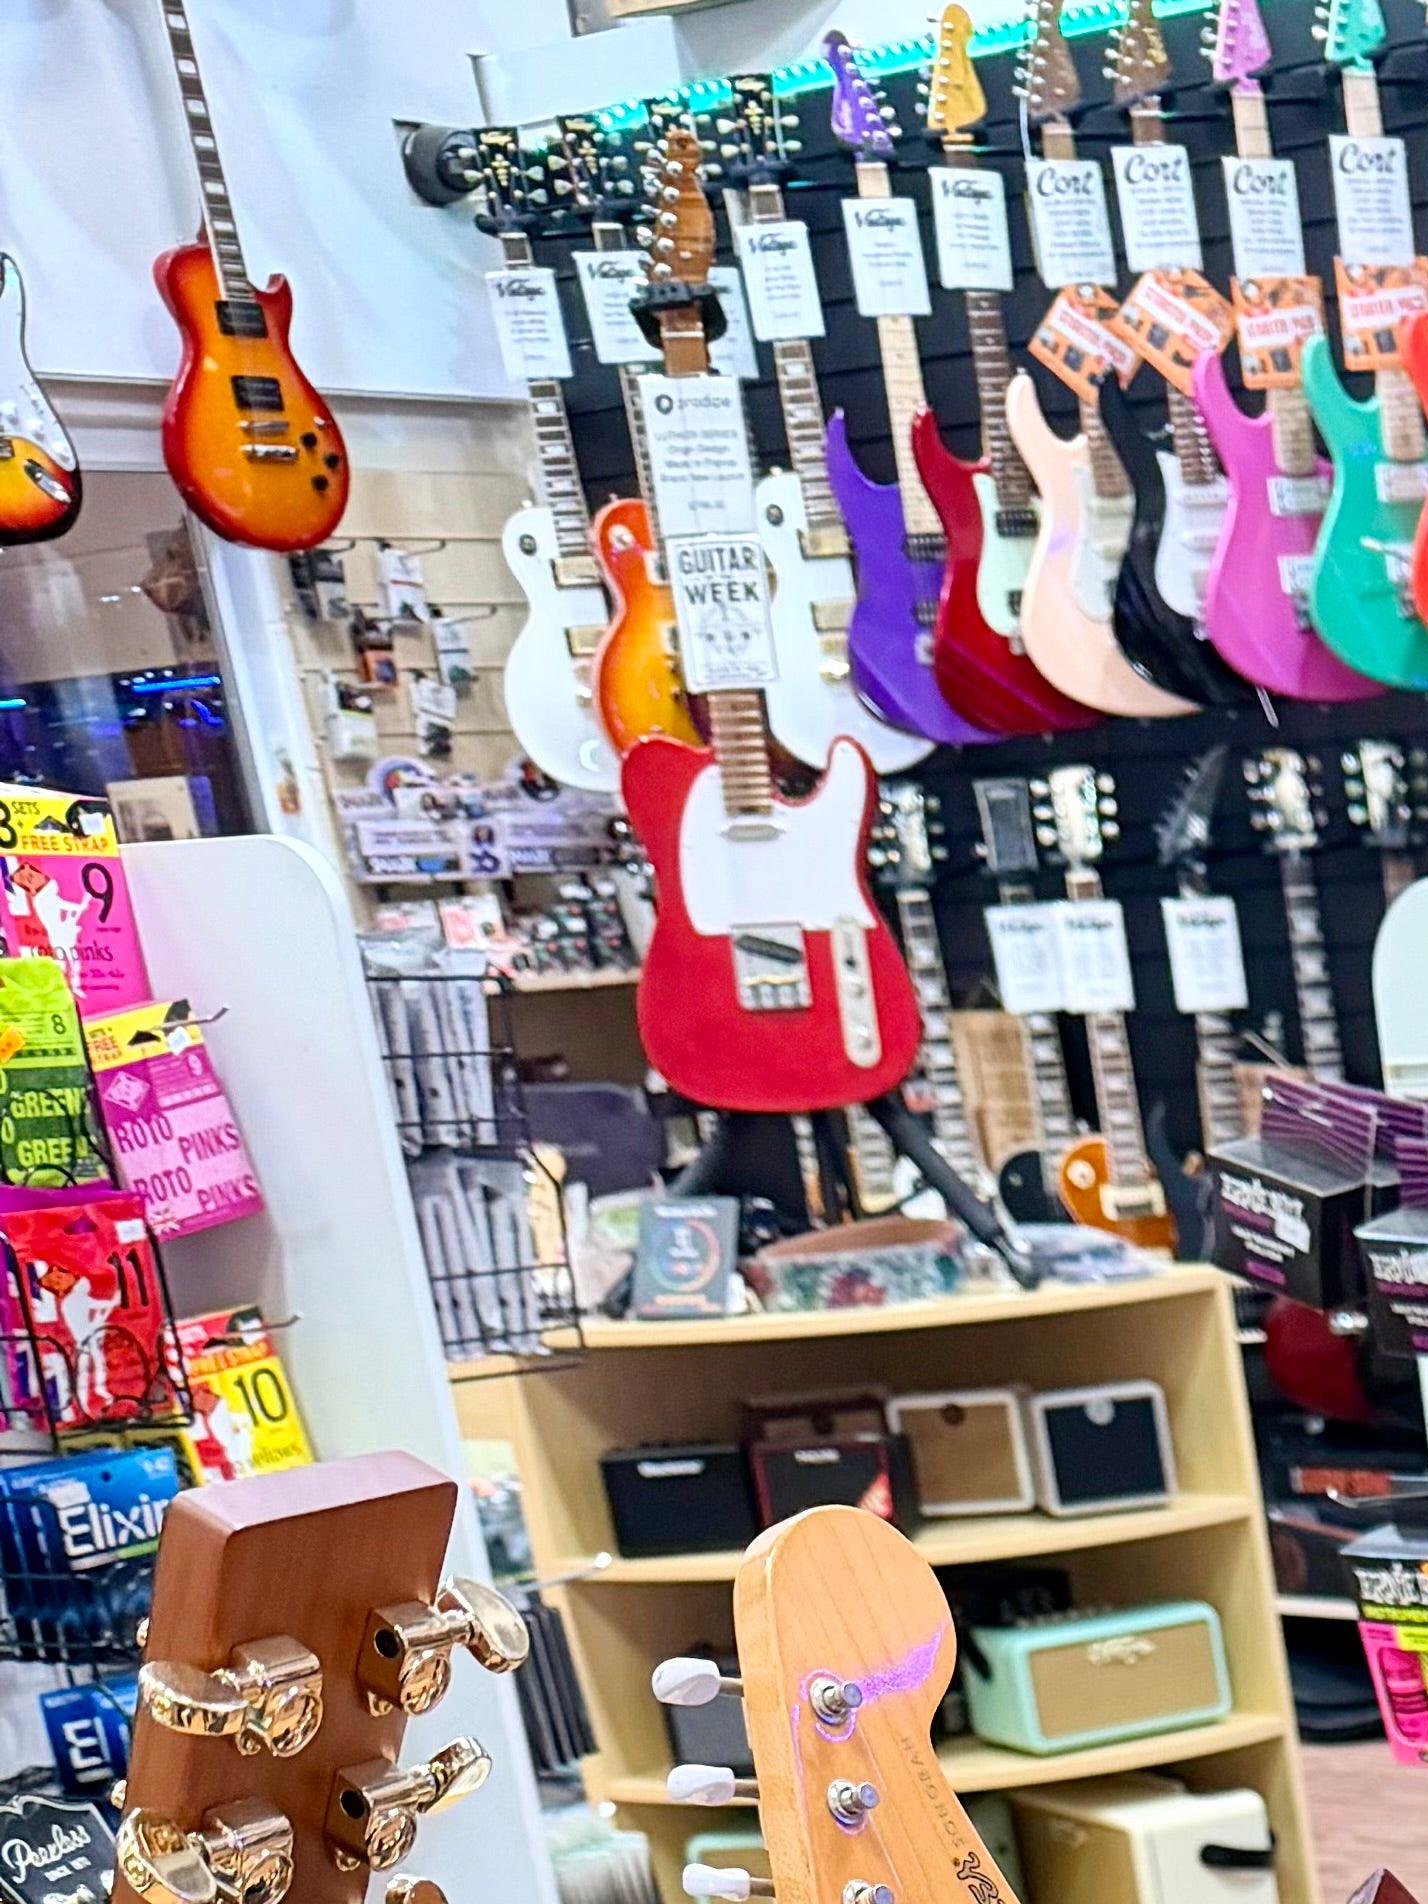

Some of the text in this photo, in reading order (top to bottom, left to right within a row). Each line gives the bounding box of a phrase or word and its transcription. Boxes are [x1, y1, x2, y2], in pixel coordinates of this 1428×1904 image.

[1125, 155, 1183, 184] Cort
[1339, 142, 1396, 175] Cort
[1036, 167, 1096, 197] Cort
[1234, 165, 1286, 195] Cort
[679, 546, 757, 575] GUITAR
[684, 581, 760, 605] WEEK
[21, 835, 109, 853] FREE STRAP
[81, 862, 114, 924] 9
[51, 1013, 66, 1035] 8
[111, 1112, 174, 1153] ROTO
[177, 1122, 241, 1164] PINKS
[133, 1166, 193, 1206] ROTO
[196, 1174, 261, 1213] PINKS
[107, 1248, 149, 1309] 11
[233, 1368, 288, 1426] 10
[2, 1824, 92, 1884] Peerless
